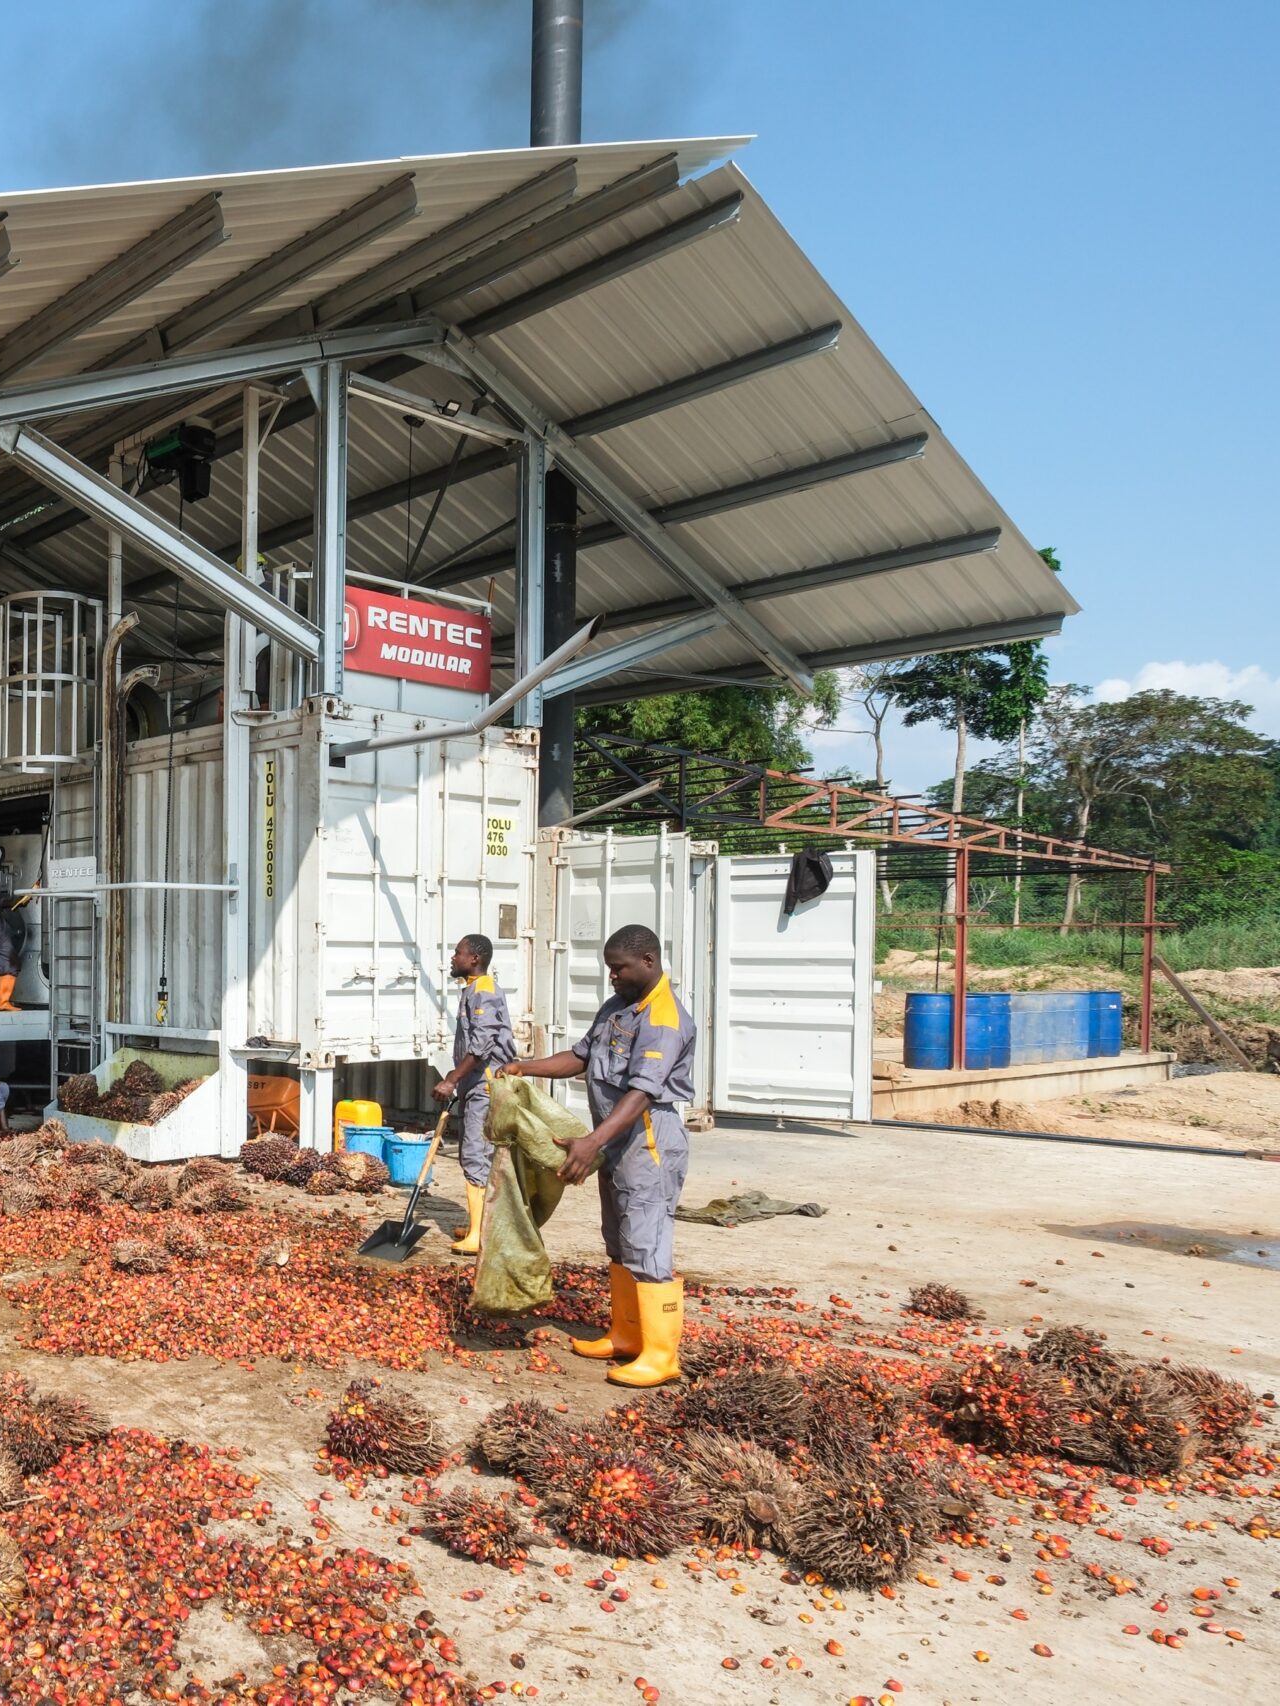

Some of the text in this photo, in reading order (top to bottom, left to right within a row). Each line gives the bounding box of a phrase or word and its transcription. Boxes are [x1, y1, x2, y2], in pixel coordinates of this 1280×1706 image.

[367, 605, 483, 649] RENTEC
[380, 643, 472, 675] MODULAR
[266, 760, 274, 897] TOLU 4760030
[487, 831, 504, 843] 476
[51, 867, 93, 879] RENTEC
